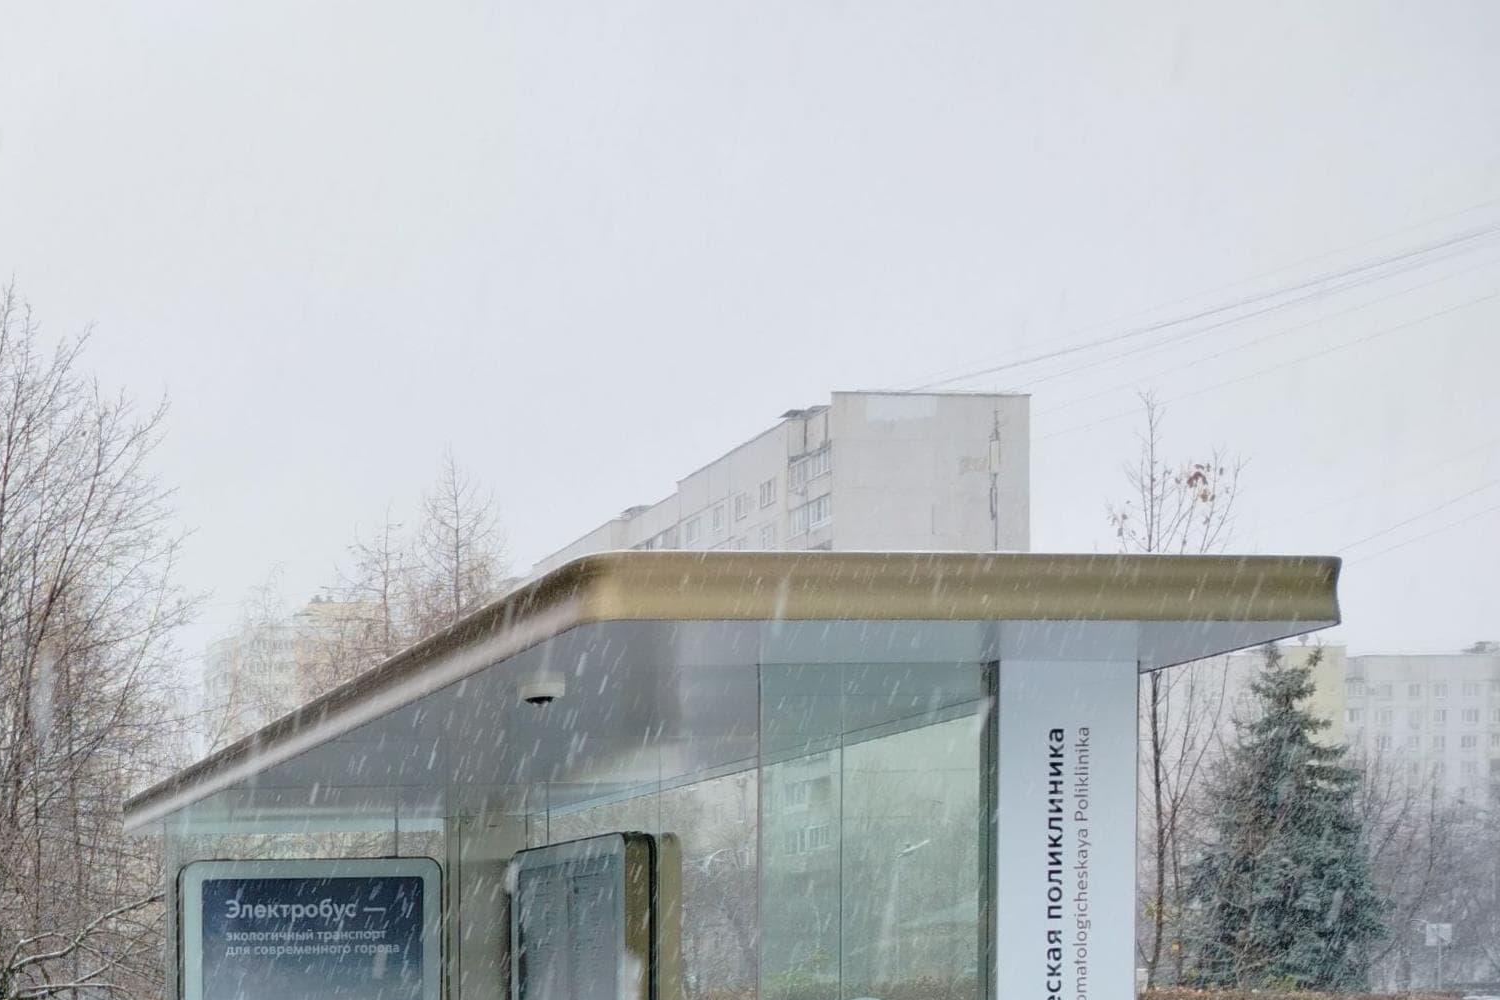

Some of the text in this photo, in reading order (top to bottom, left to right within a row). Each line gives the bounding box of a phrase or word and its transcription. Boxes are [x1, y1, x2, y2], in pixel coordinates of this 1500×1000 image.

[1074, 727, 1090, 821] Poliklinika
[1047, 728, 1065, 919] поликлиника
[225, 899, 357, 922] Электробус
[226, 929, 387, 942] экологичный транспорт
[225, 943, 400, 957] для современного города
